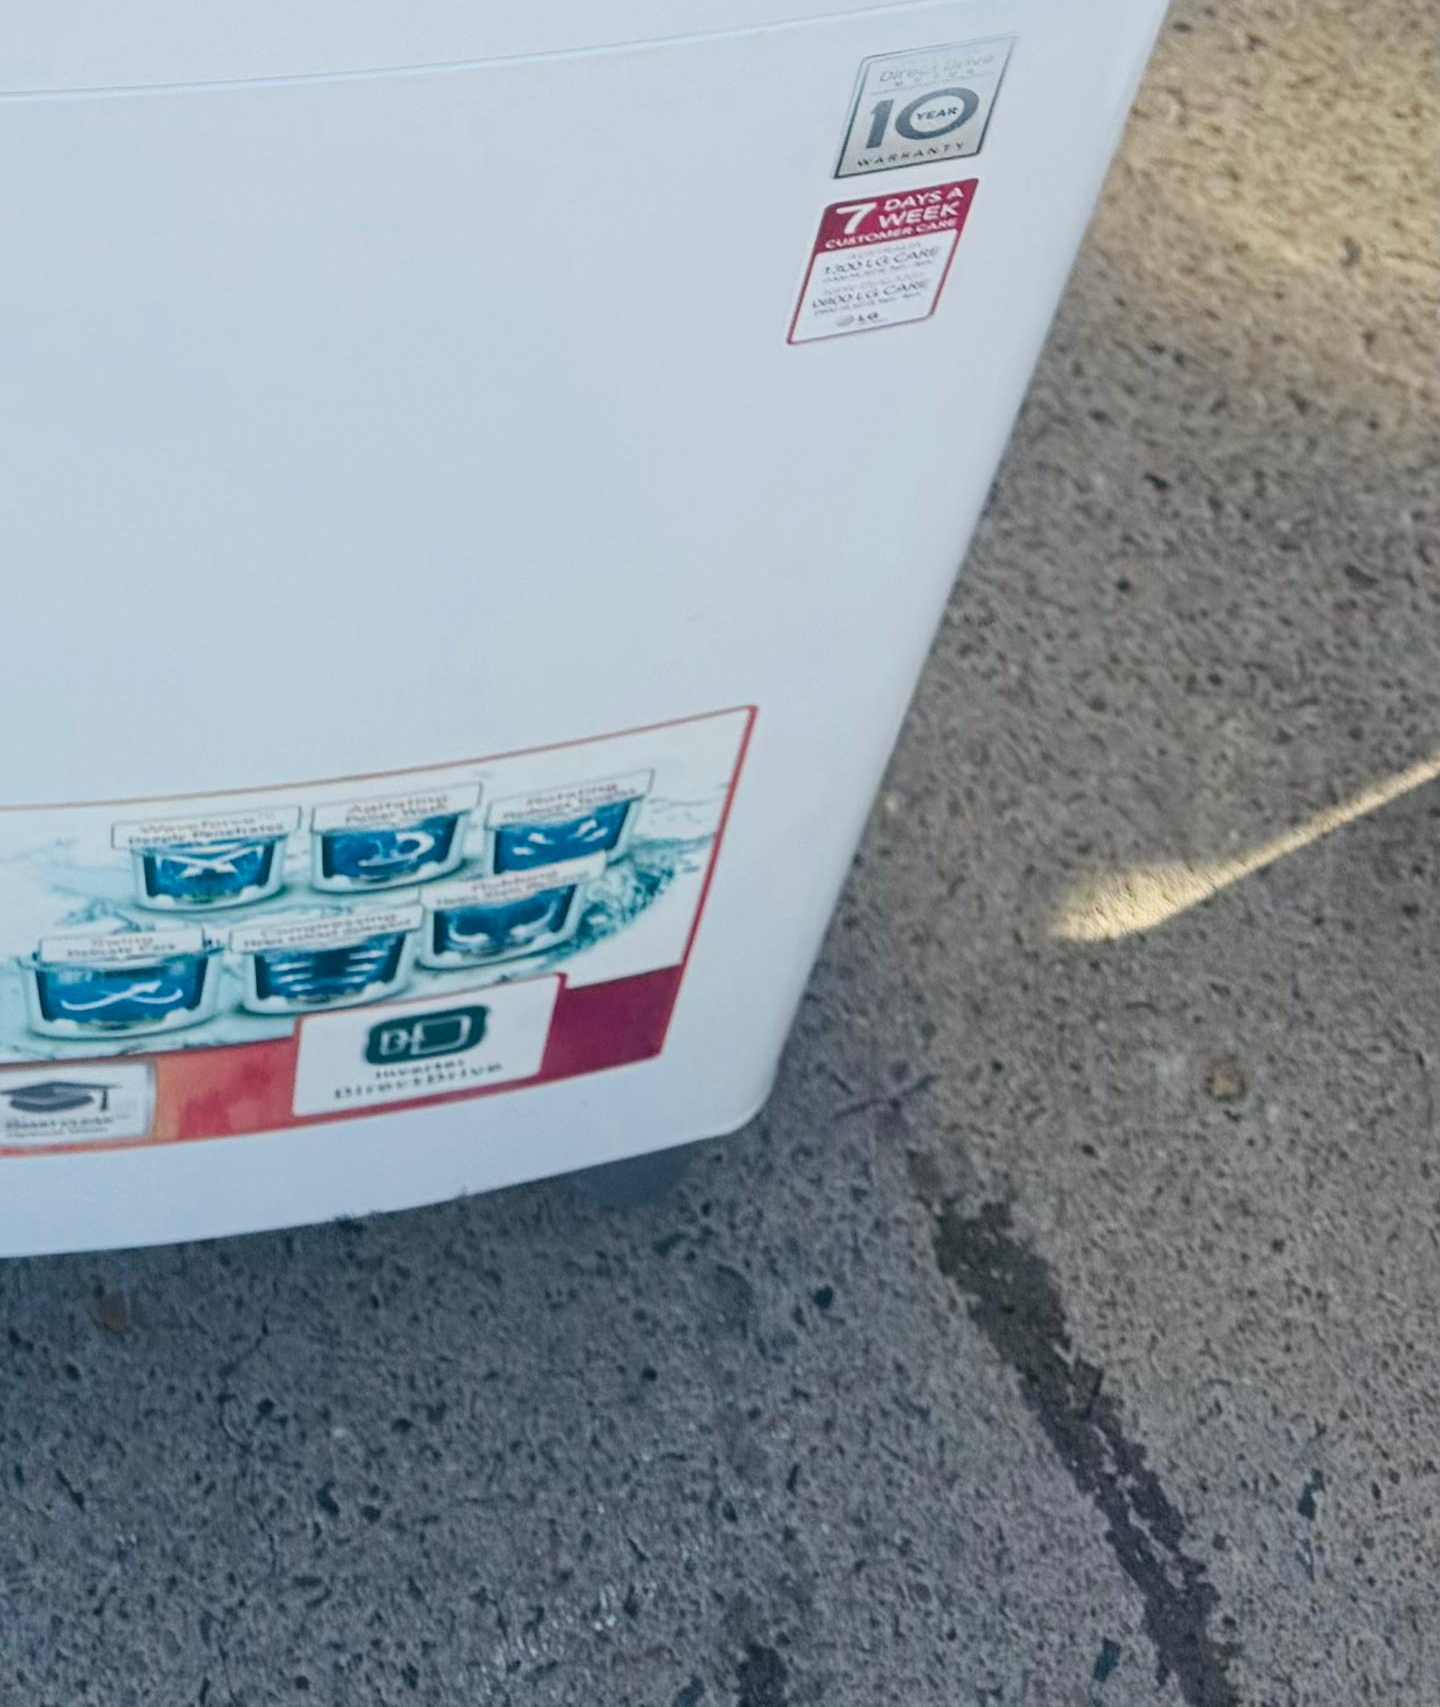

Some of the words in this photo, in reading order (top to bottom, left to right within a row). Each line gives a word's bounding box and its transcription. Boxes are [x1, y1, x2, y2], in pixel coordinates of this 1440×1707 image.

[915, 105, 959, 122] YEAR
[857, 141, 965, 167] WARRANTY
[883, 189, 943, 212] DAYS
[945, 185, 965, 200] A
[836, 202, 877, 235] 7
[878, 201, 961, 229] WEEK
[825, 226, 913, 250] CUSTOMER
